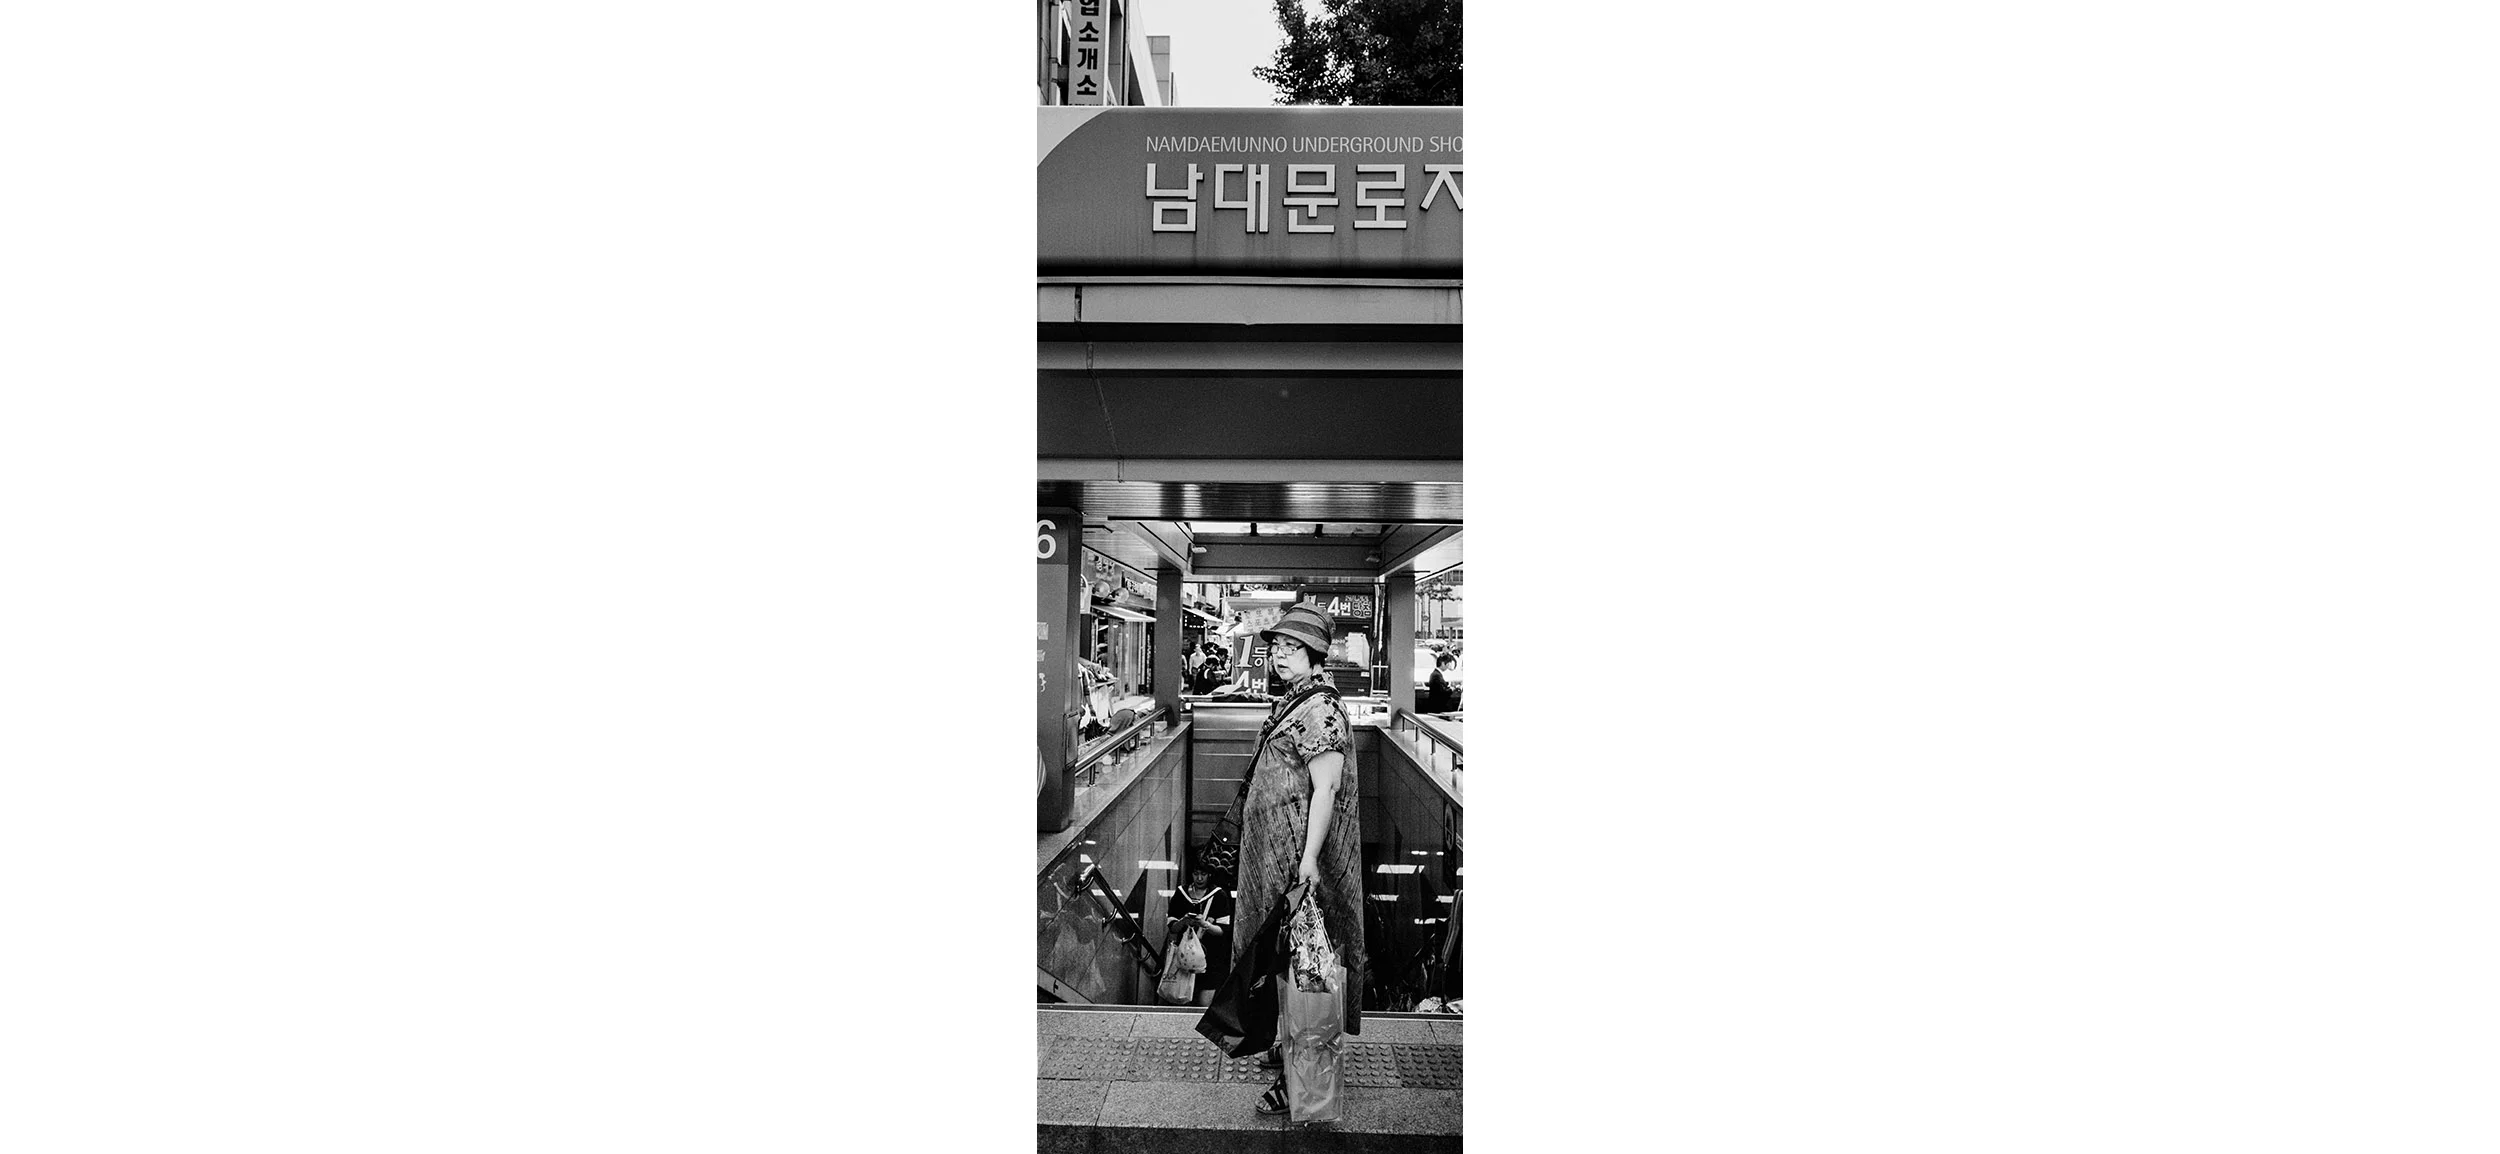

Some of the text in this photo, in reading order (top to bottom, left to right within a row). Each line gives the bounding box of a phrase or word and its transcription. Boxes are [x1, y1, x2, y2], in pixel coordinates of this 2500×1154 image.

[1146, 136, 1288, 153] NAMDAEMUNNO
[1292, 136, 1424, 153] UNDERGROUND
[1037, 519, 1057, 559] 6
[1327, 596, 1351, 616] 4번
[1235, 634, 1268, 668] 1등
